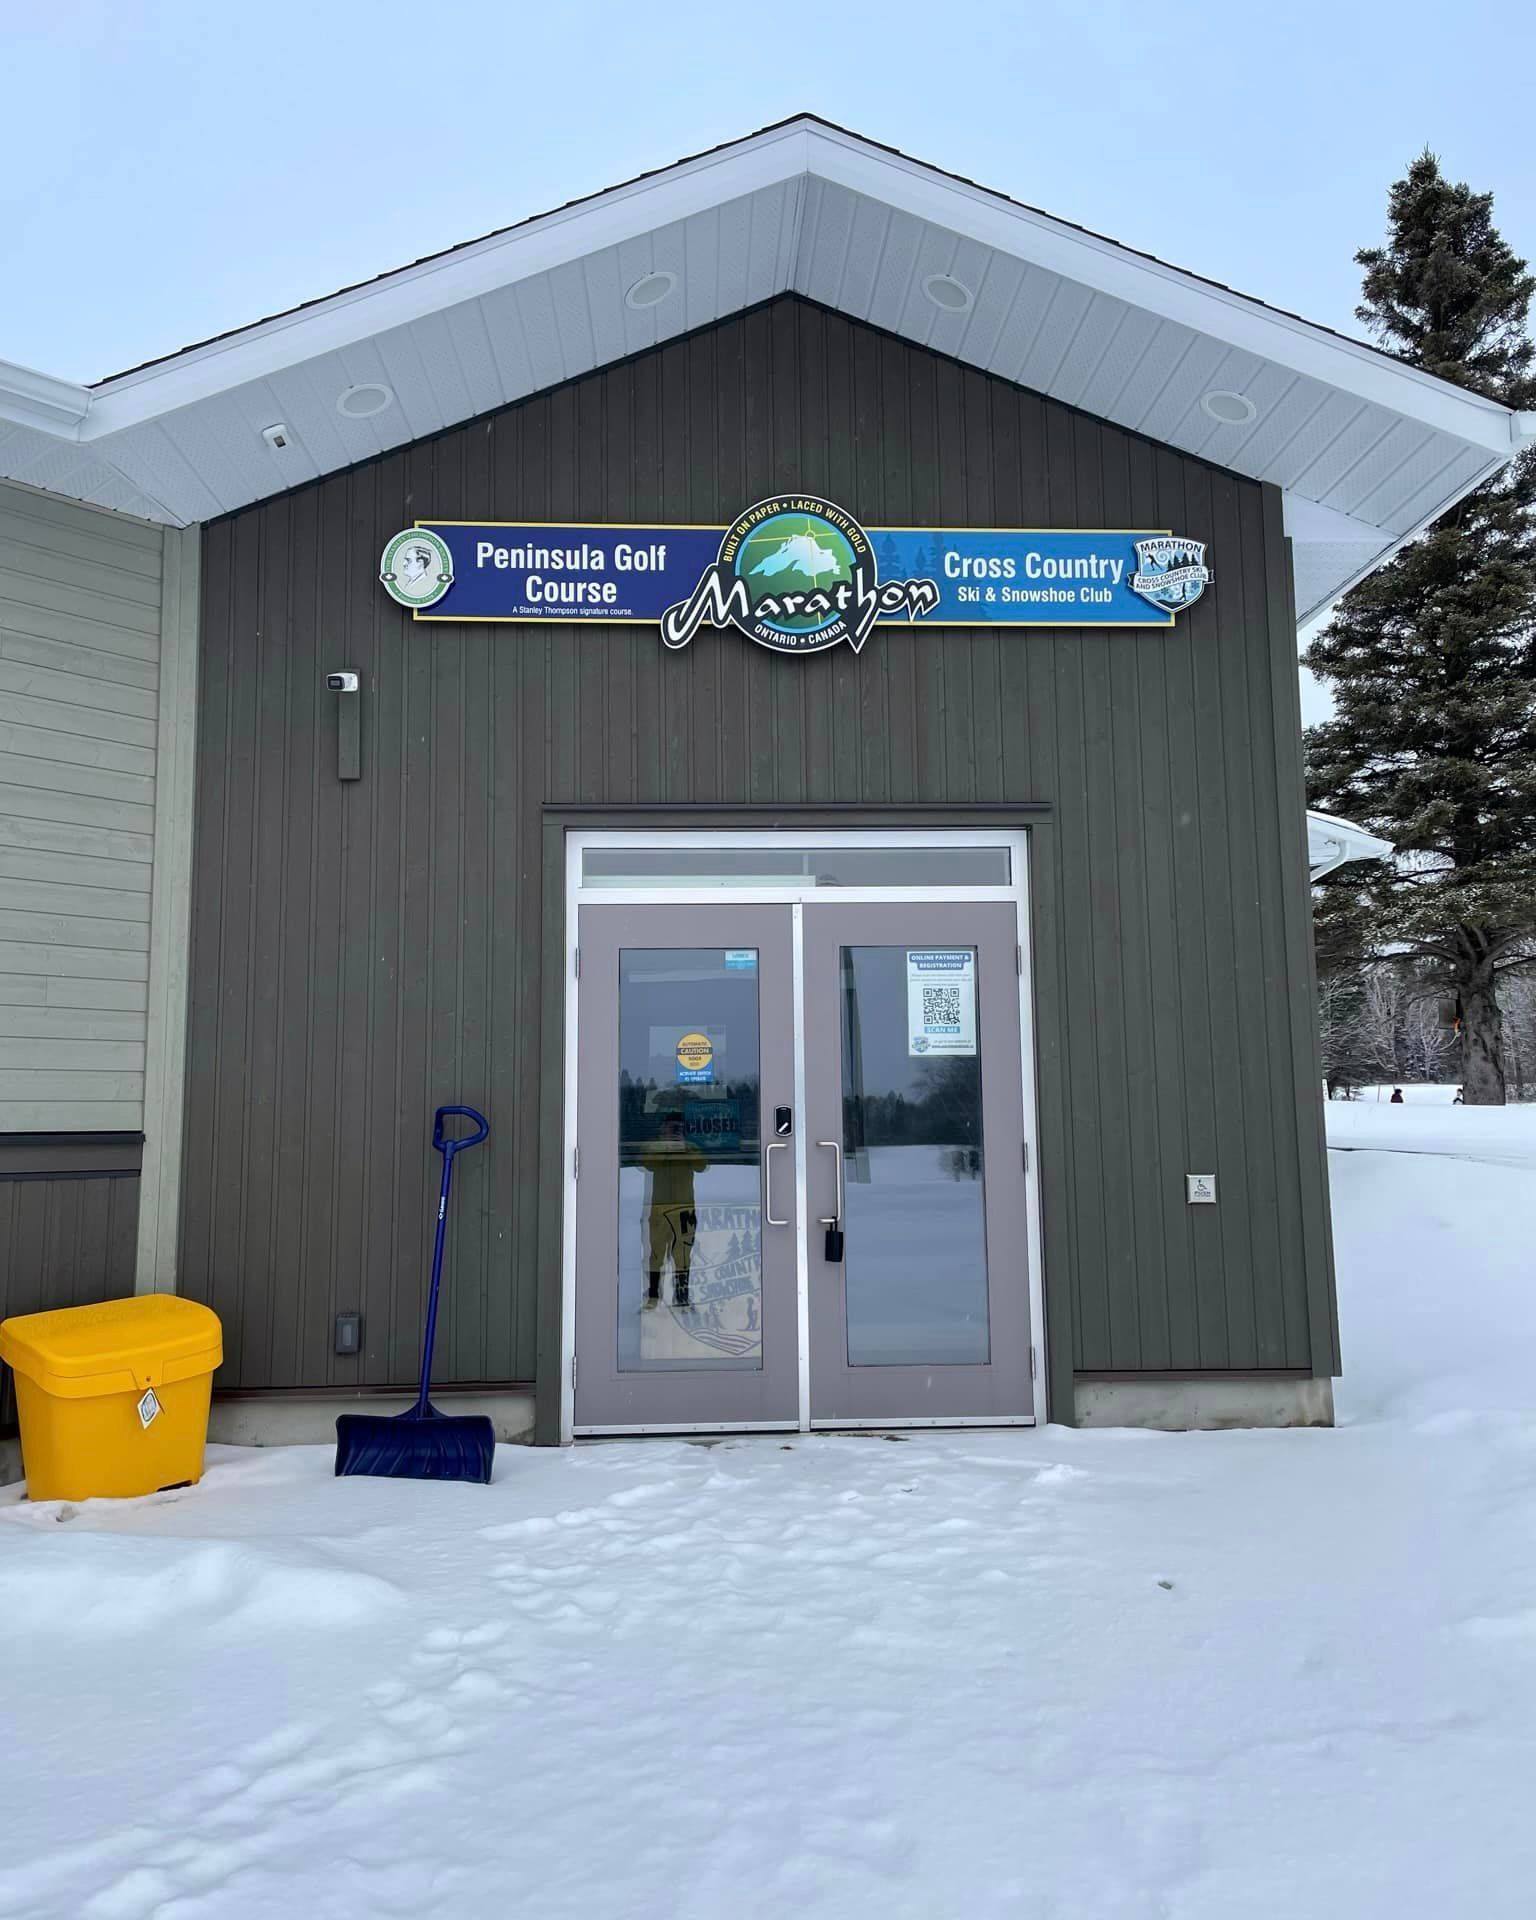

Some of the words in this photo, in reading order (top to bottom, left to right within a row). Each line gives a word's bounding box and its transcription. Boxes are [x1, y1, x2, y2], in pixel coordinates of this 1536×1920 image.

[723, 537, 739, 563] BUILT
[737, 520, 751, 534] ON
[750, 502, 780, 523] PAPER
[791, 500, 823, 513] LACED
[825, 508, 848, 527] WITH
[847, 527, 866, 553] GOLD
[1140, 540, 1202, 553] MARATHON
[476, 542, 605, 570] Peninsula
[614, 544, 667, 571] Golf
[944, 551, 1017, 579] Cross
[1025, 552, 1124, 585] Country
[1137, 576, 1160, 584] CROSS
[1160, 567, 1191, 581] COUNTRY
[525, 575, 617, 603] Course
[1136, 582, 1151, 590] AND
[1151, 573, 1189, 589] SNOWSHOE
[957, 586, 980, 602] Ski
[985, 587, 996, 602] &
[1001, 586, 1076, 603] Snowshoe
[1080, 587, 1113, 603] Club
[519, 606, 542, 615] Stanley
[544, 606, 578, 615] Thompson
[580, 607, 608, 616] signature
[667, 567, 937, 641] Marathon
[754, 623, 797, 646] ONTARIO
[808, 621, 847, 645] CANADA
[680, 1047, 710, 1055] CAUTION
[685, 1118, 737, 1133] CLOSED
